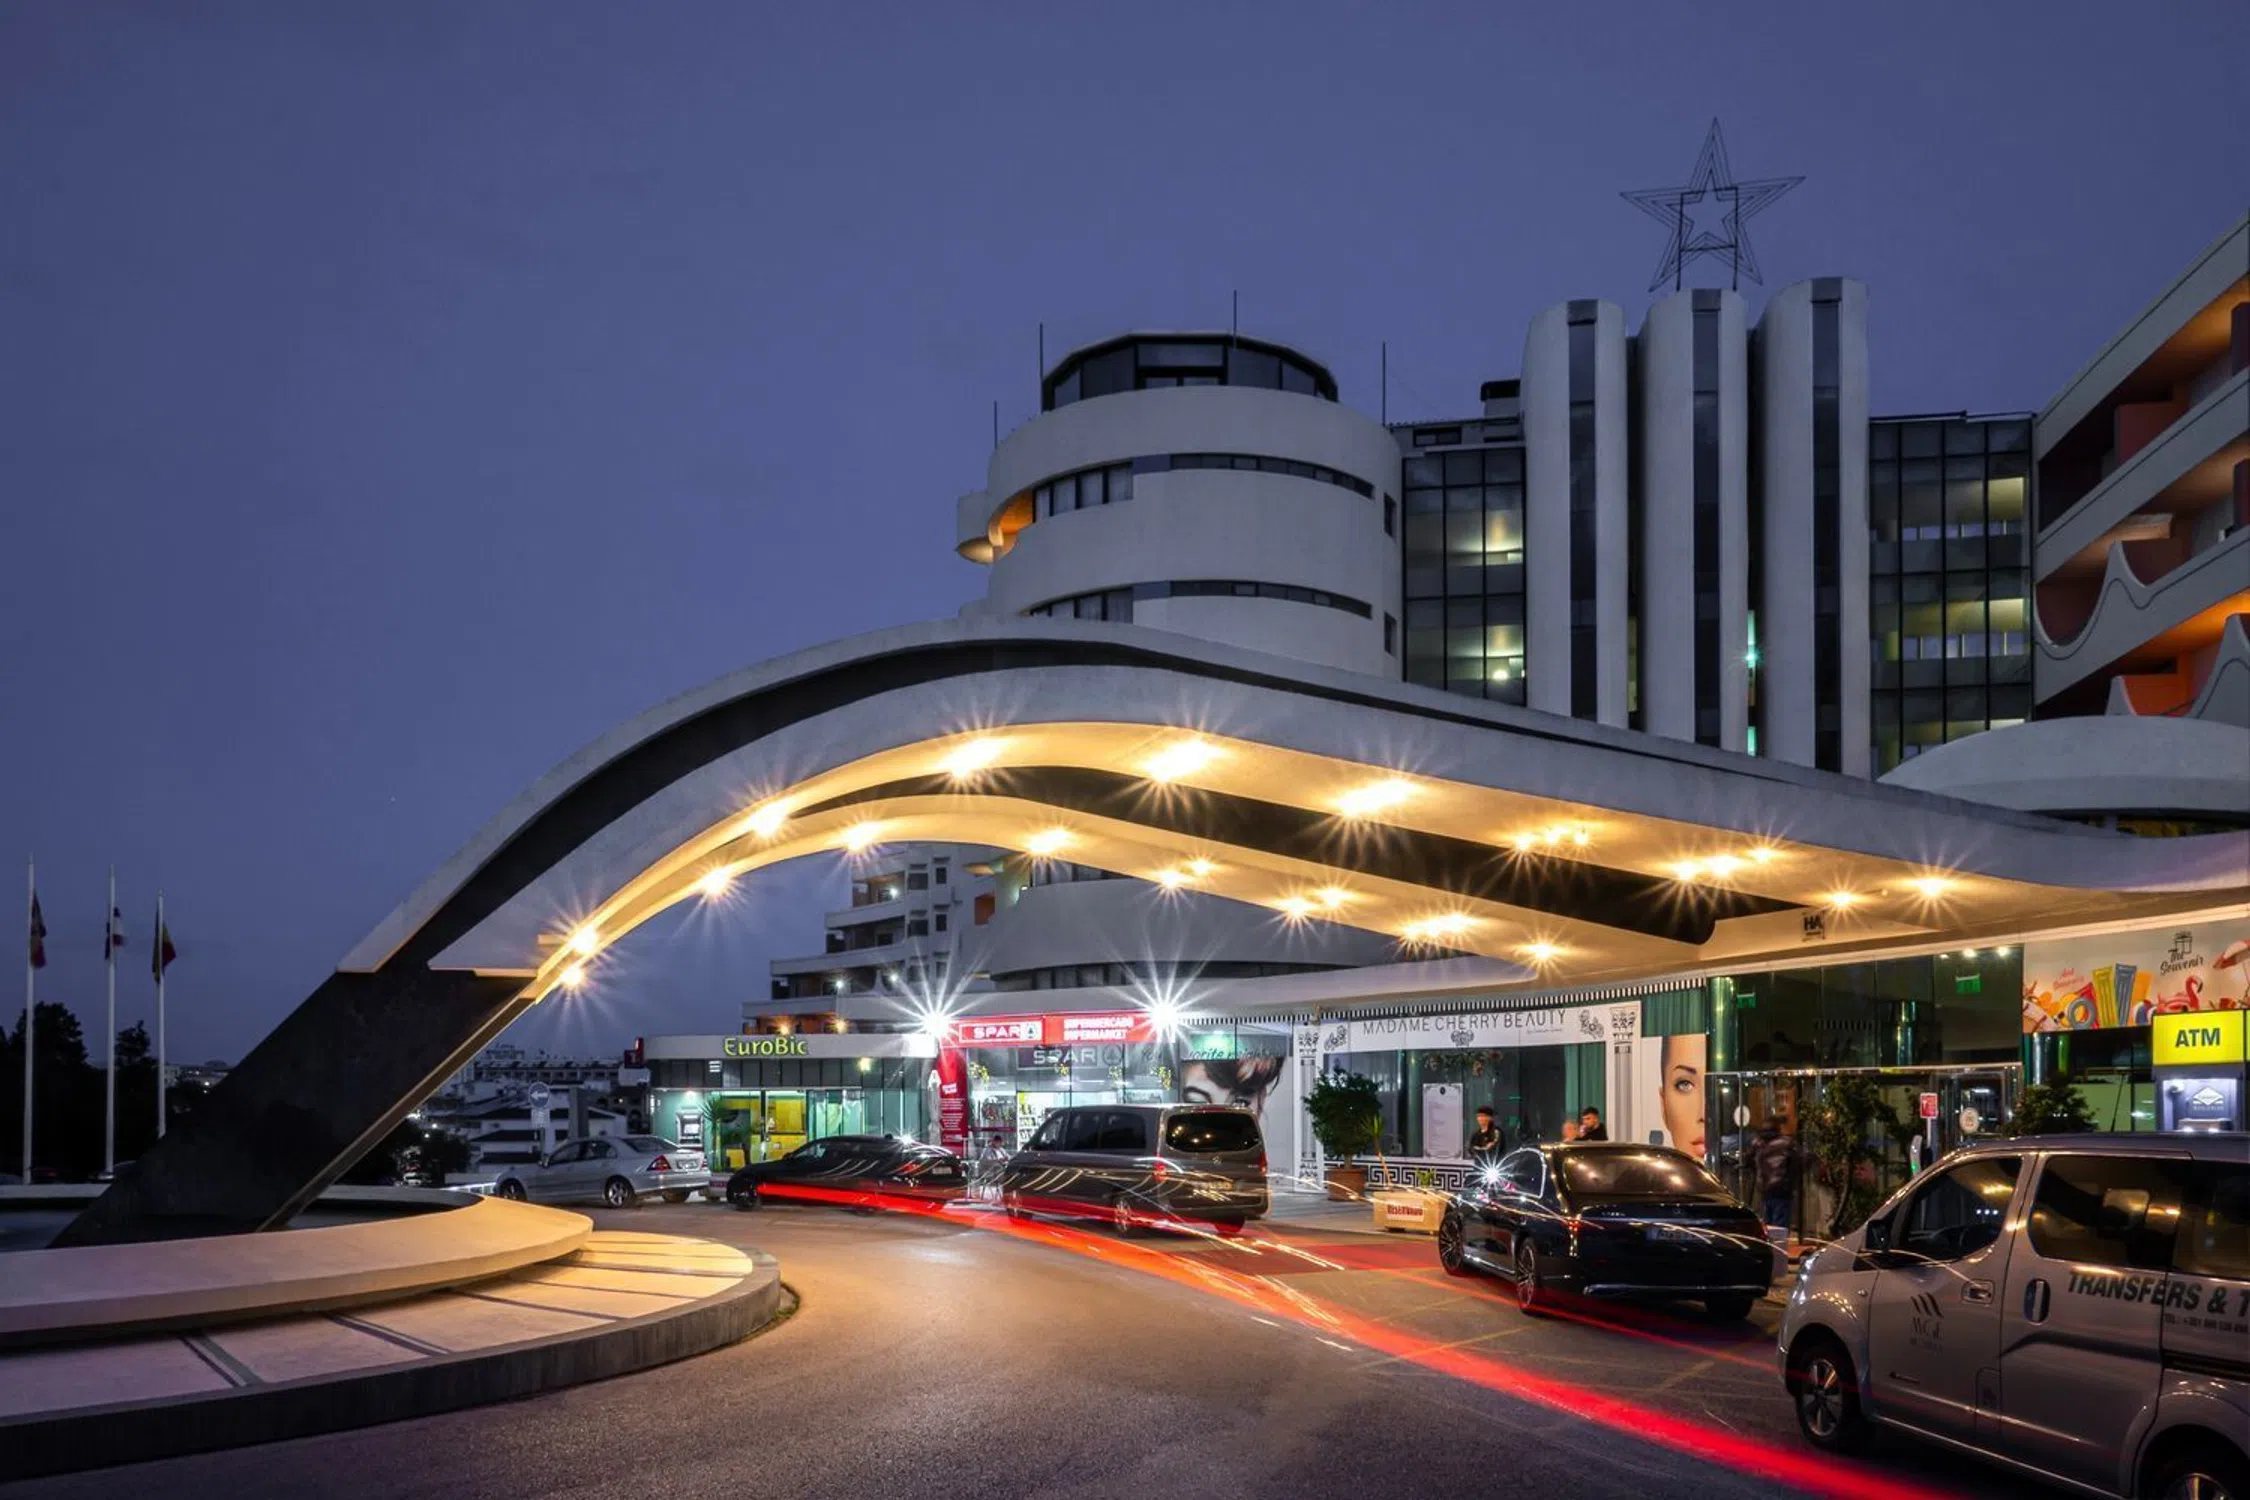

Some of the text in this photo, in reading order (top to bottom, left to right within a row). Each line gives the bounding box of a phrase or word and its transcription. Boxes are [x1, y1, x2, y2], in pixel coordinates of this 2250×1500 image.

[1363, 1009, 1566, 1035] MADAME CHERRY BEAUTY
[973, 1026, 1021, 1039] SPAR
[2175, 1027, 2221, 1048] ATM
[723, 1036, 808, 1056] EuroBic
[1033, 1049, 1096, 1065] SPAR
[2068, 1271, 2203, 1310] TRANSFERS
[2206, 1285, 2228, 1315] &
